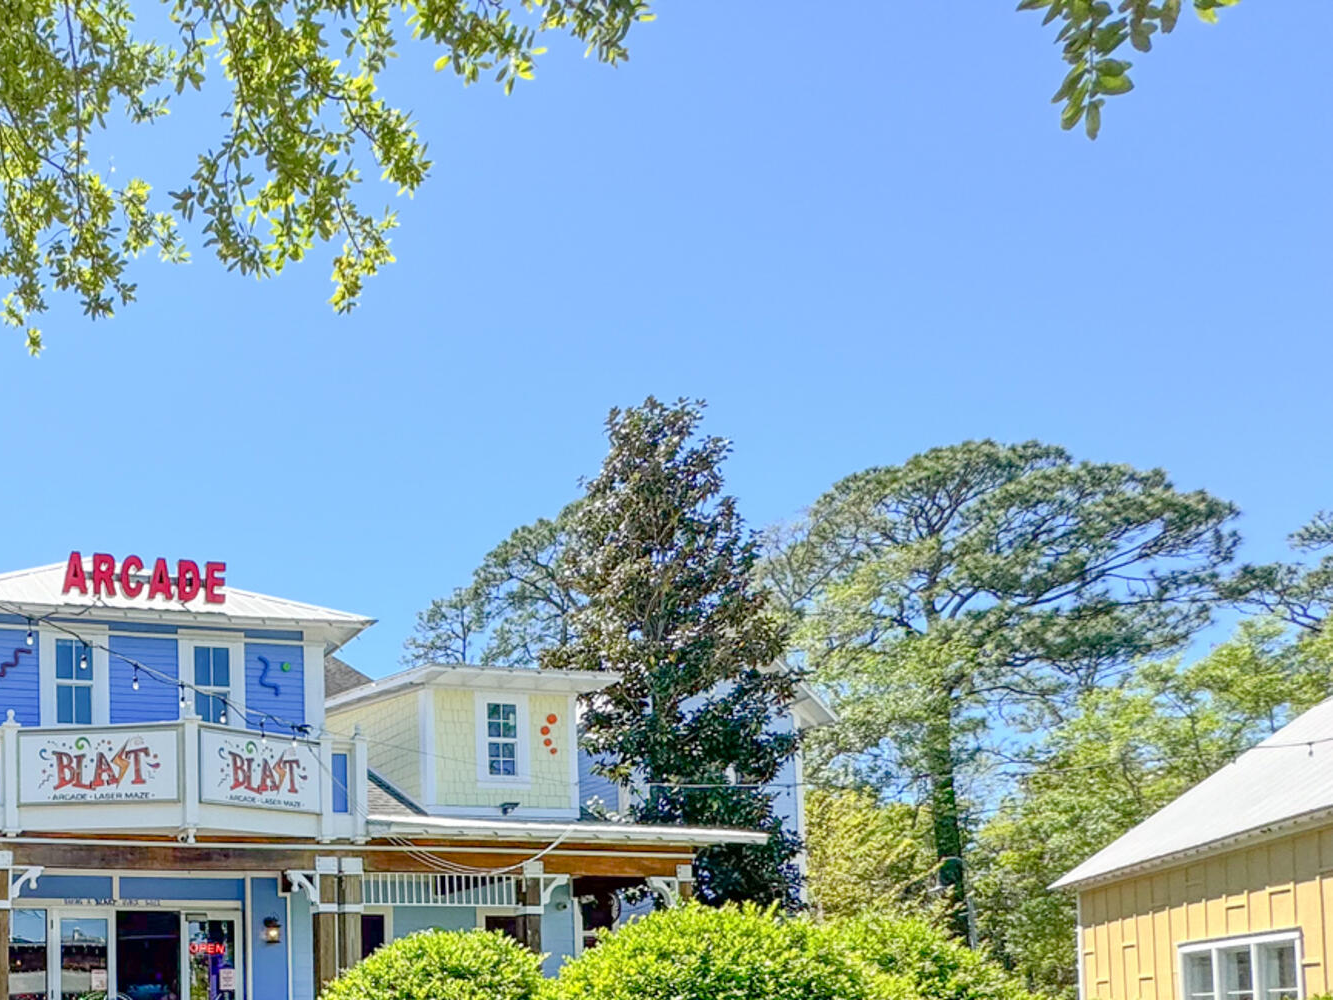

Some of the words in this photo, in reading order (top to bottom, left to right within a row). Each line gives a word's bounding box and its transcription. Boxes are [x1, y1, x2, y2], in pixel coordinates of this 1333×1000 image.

[62, 550, 226, 604] ARCADE
[51, 737, 151, 791] BLAST
[228, 750, 300, 796] BLAST
[52, 793, 87, 801] ARCADE
[125, 791, 150, 799] MAZE
[189, 942, 225, 955] OPEN
